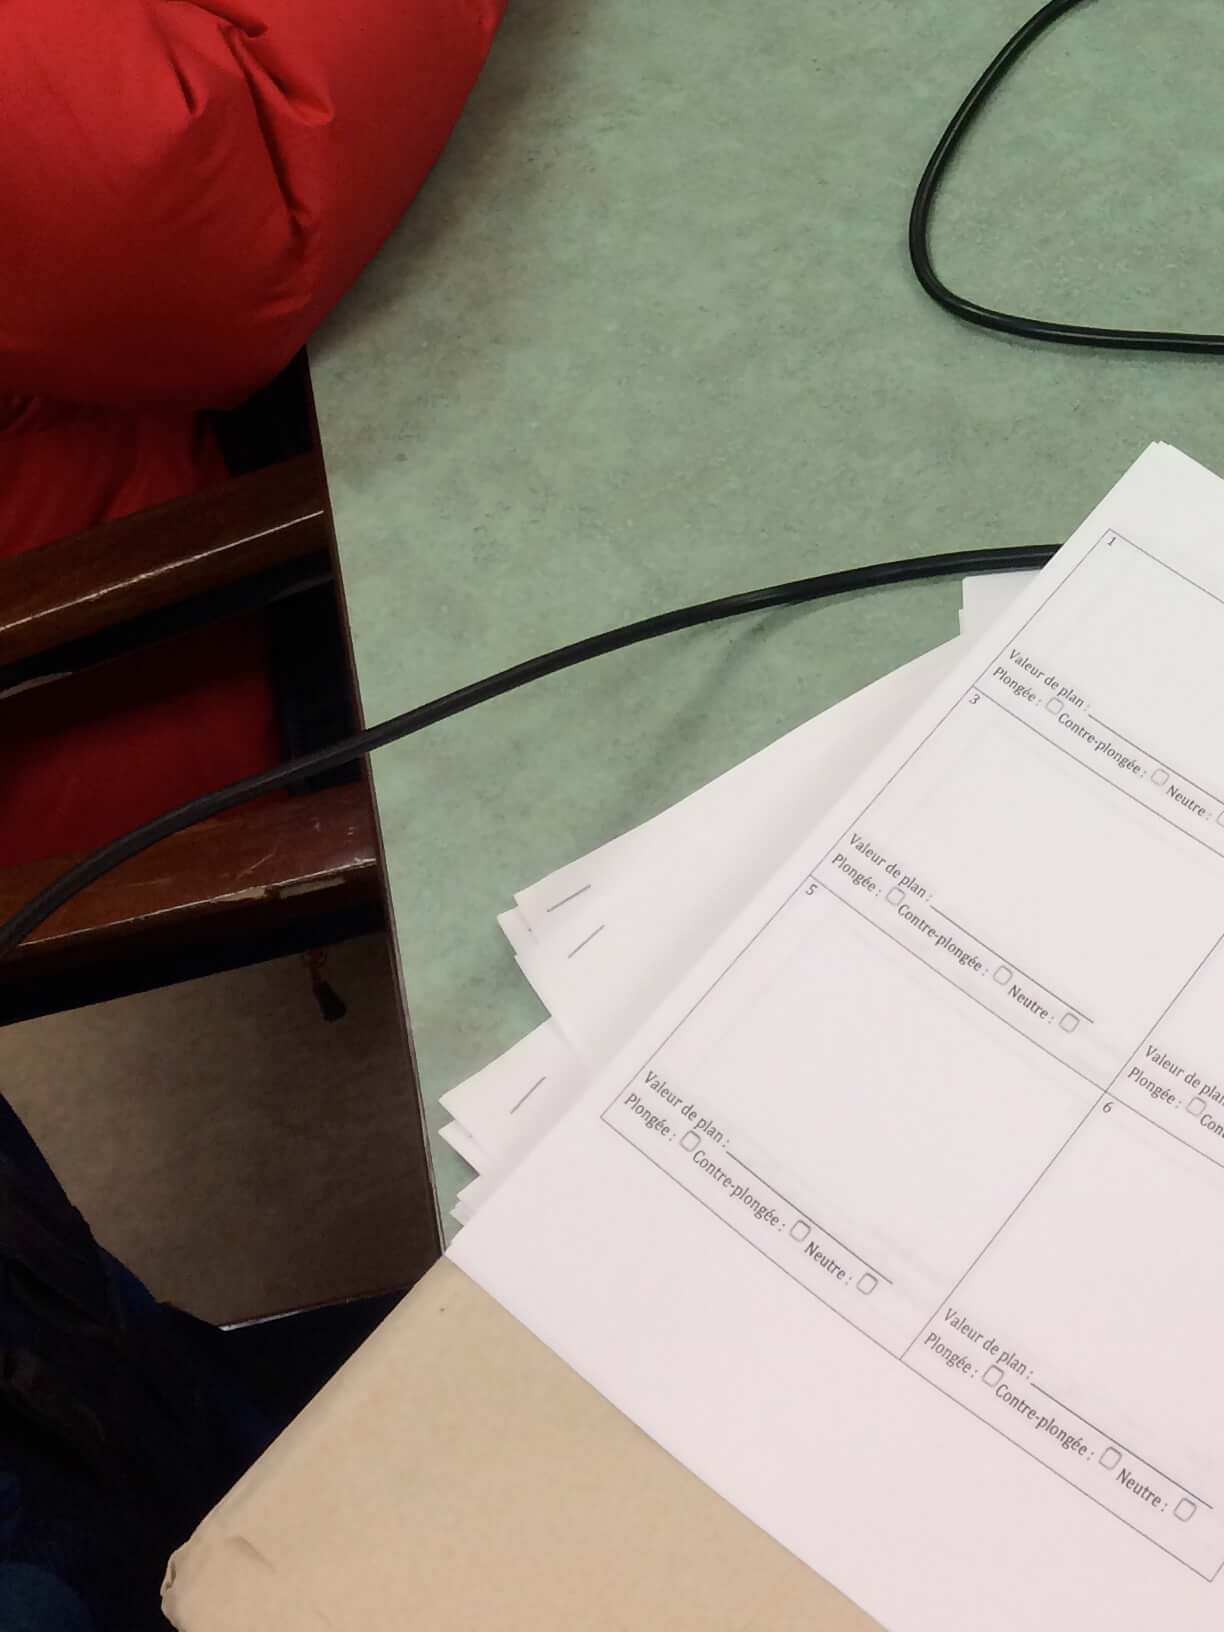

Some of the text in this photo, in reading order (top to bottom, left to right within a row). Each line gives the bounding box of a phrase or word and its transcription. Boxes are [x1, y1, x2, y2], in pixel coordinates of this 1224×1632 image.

[1107, 534, 1116, 546] 1
[968, 692, 980, 705] 3
[1009, 648, 1045, 679] Valeur
[1043, 676, 1060, 690] de
[1056, 686, 1085, 708] plan
[992, 666, 1037, 702] Plongée
[1057, 712, 1141, 774] Contre-plongée
[1166, 784, 1206, 817] Neutre
[804, 882, 817, 897] 5
[849, 832, 887, 866] Valeur
[884, 863, 901, 879] de
[897, 875, 927, 899] plan
[831, 853, 877, 892] Plongée
[897, 903, 983, 972] Contre-plongée
[1007, 984, 1049, 1020] Neutre
[1127, 1066, 1176, 1105] Plongée
[1145, 1044, 1185, 1077] Valeur
[1183, 1072, 1201, 1089] de
[644, 1070, 684, 1107] Valeur
[680, 1104, 698, 1121] de
[692, 1117, 724, 1144] plan
[1102, 1100, 1113, 1114] 6
[623, 1092, 671, 1137] Plongée
[692, 1149, 780, 1227] Contre-plongée
[804, 1240, 846, 1280] Neutre
[944, 1307, 985, 1343] Valeur
[982, 1337, 1000, 1356] de
[995, 1351, 1027, 1376] plan
[923, 1331, 972, 1374] Plongée
[995, 1383, 1088, 1456] Contre-plongée
[1115, 1467, 1162, 1508] Neutre
